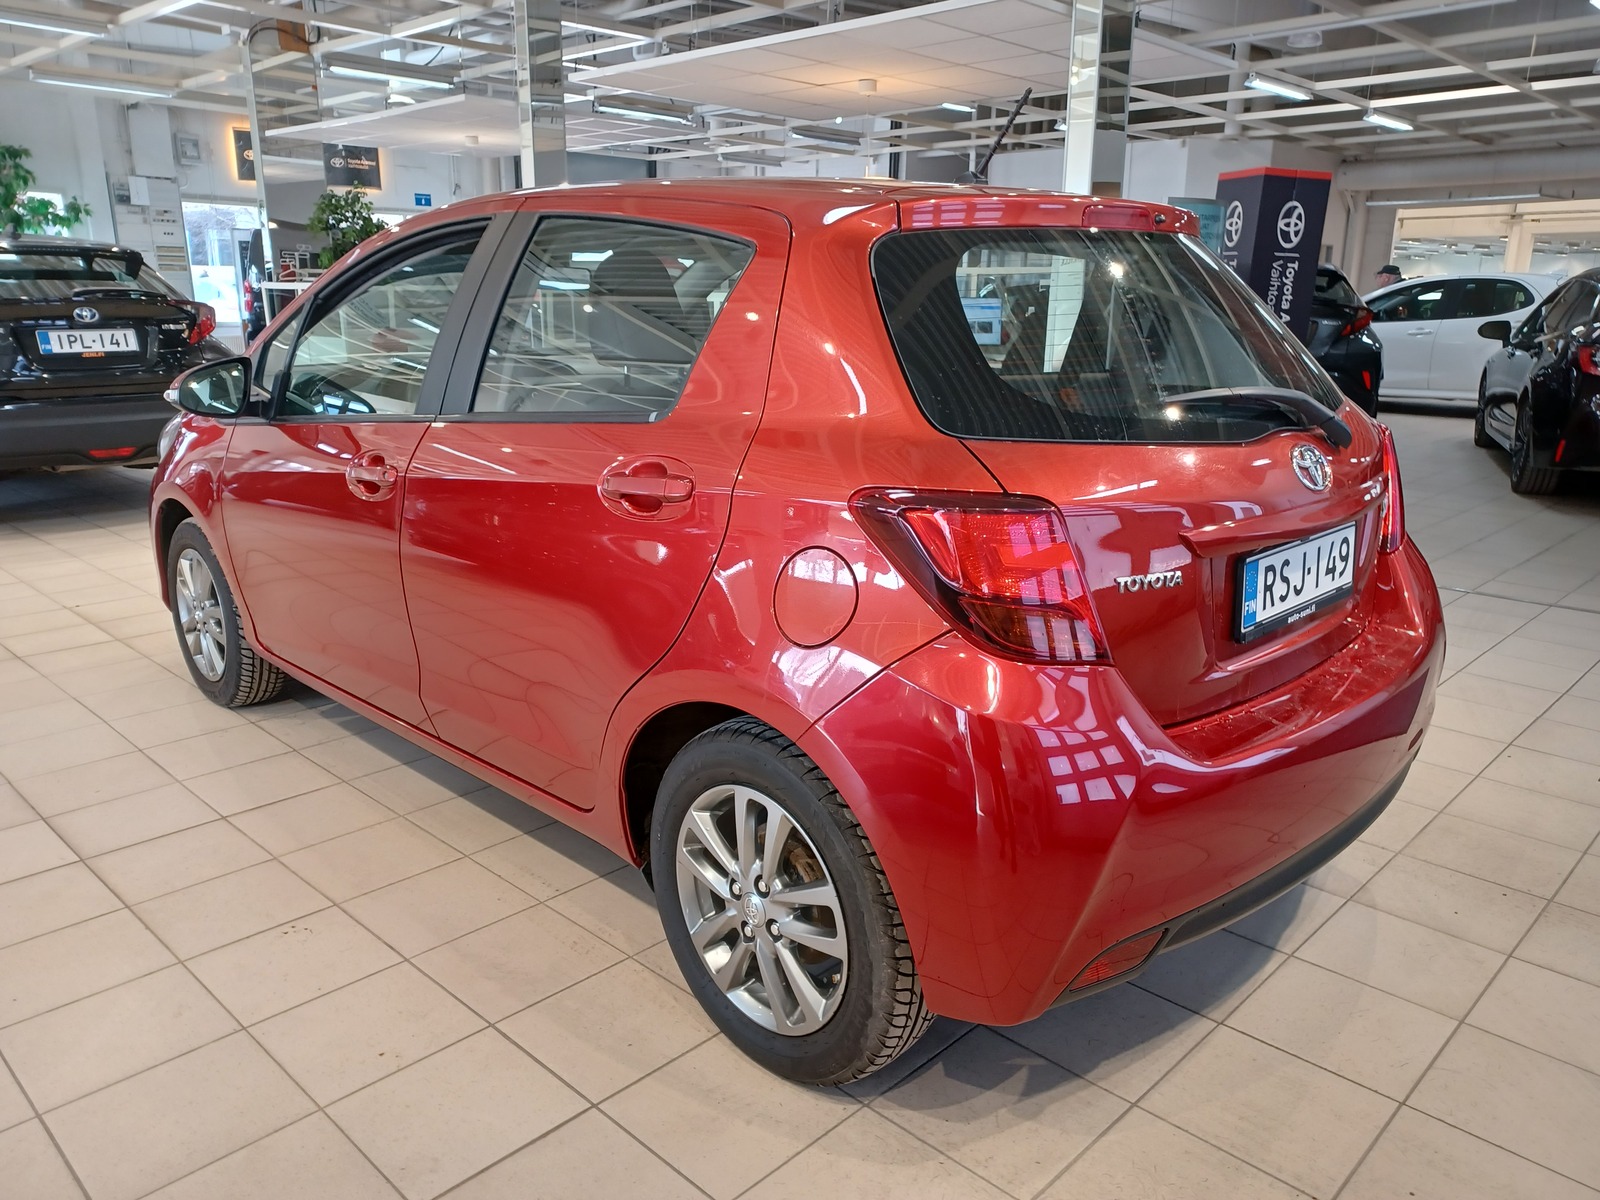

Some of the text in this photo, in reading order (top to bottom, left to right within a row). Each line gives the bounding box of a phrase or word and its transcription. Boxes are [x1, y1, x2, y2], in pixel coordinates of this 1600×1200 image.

[1281, 260, 1299, 310] Toyota
[1115, 570, 1183, 594] TOYOTA
[1262, 536, 1350, 611] RSJ-149
[1244, 599, 1257, 616] FIN
